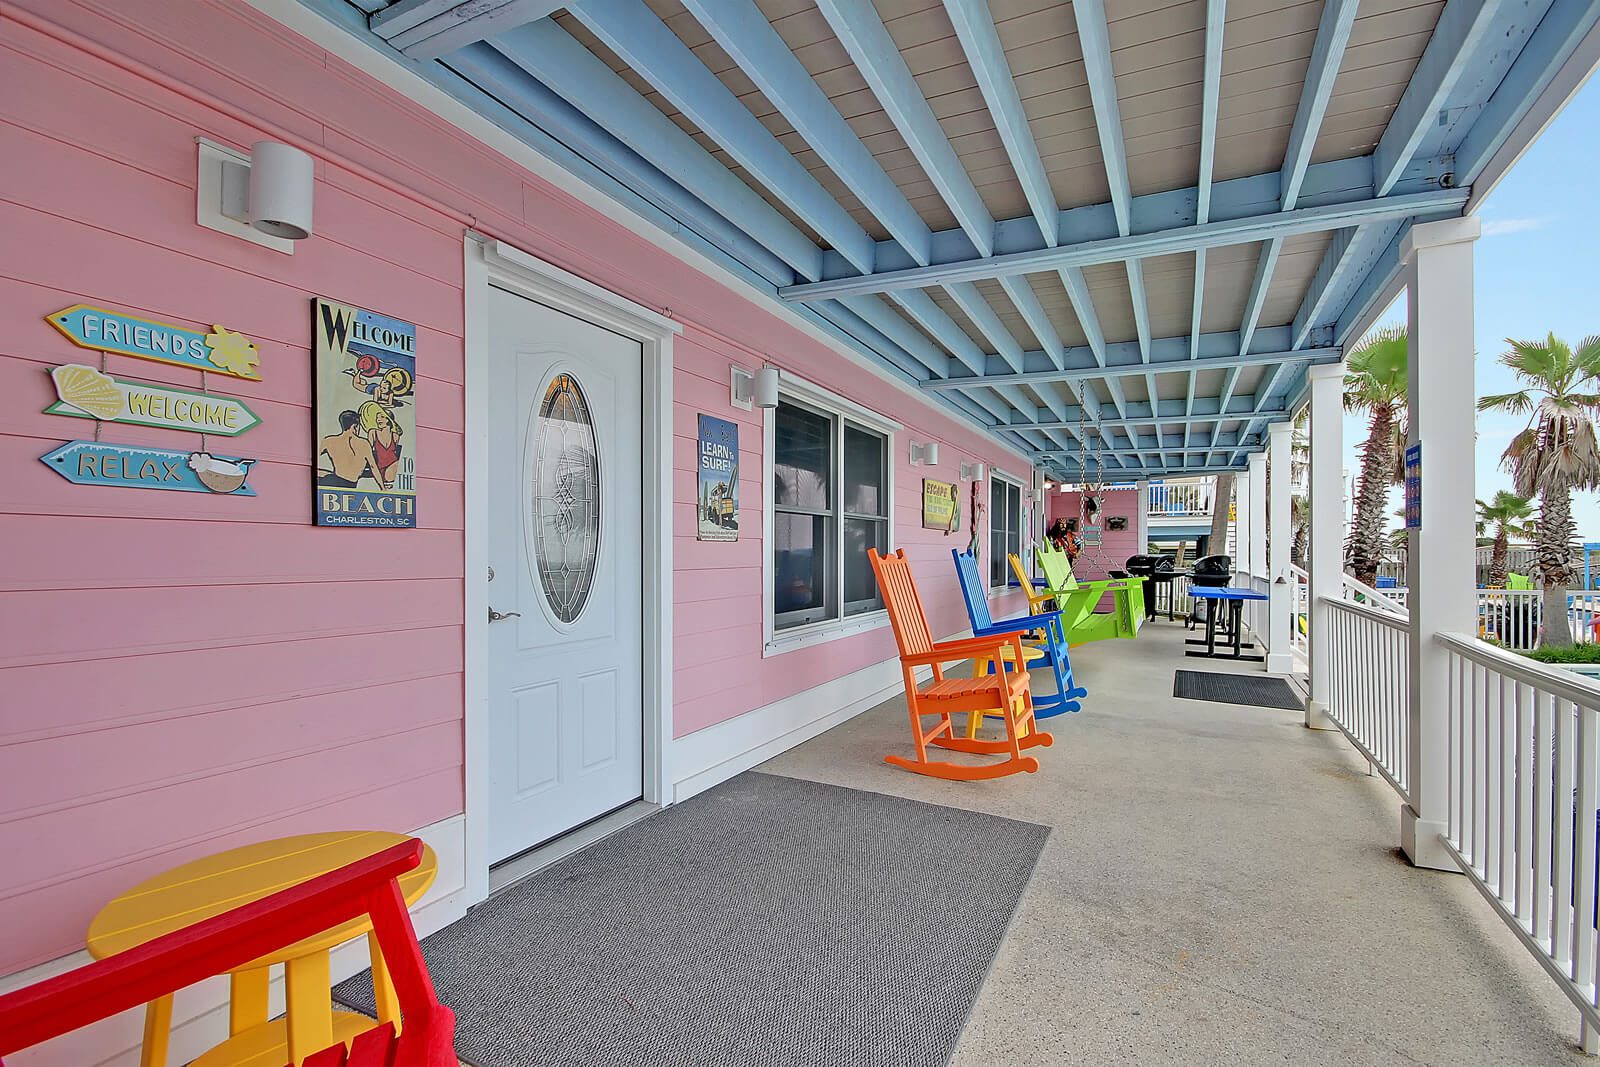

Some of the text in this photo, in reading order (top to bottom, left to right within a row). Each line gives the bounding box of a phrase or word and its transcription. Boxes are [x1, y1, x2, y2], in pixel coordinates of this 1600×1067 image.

[82, 314, 205, 359] FRIENDS
[321, 303, 414, 354] WELCOME
[128, 391, 240, 428] WELCOME
[702, 440, 729, 459] LEARN
[77, 453, 183, 482] RELAX
[403, 456, 414, 473] TO
[702, 456, 731, 473] SURF!
[398, 473, 415, 491] THE
[926, 483, 948, 498] ESCAPE
[322, 493, 414, 515] BEACH
[326, 515, 410, 526] CHARLESTON, SC
